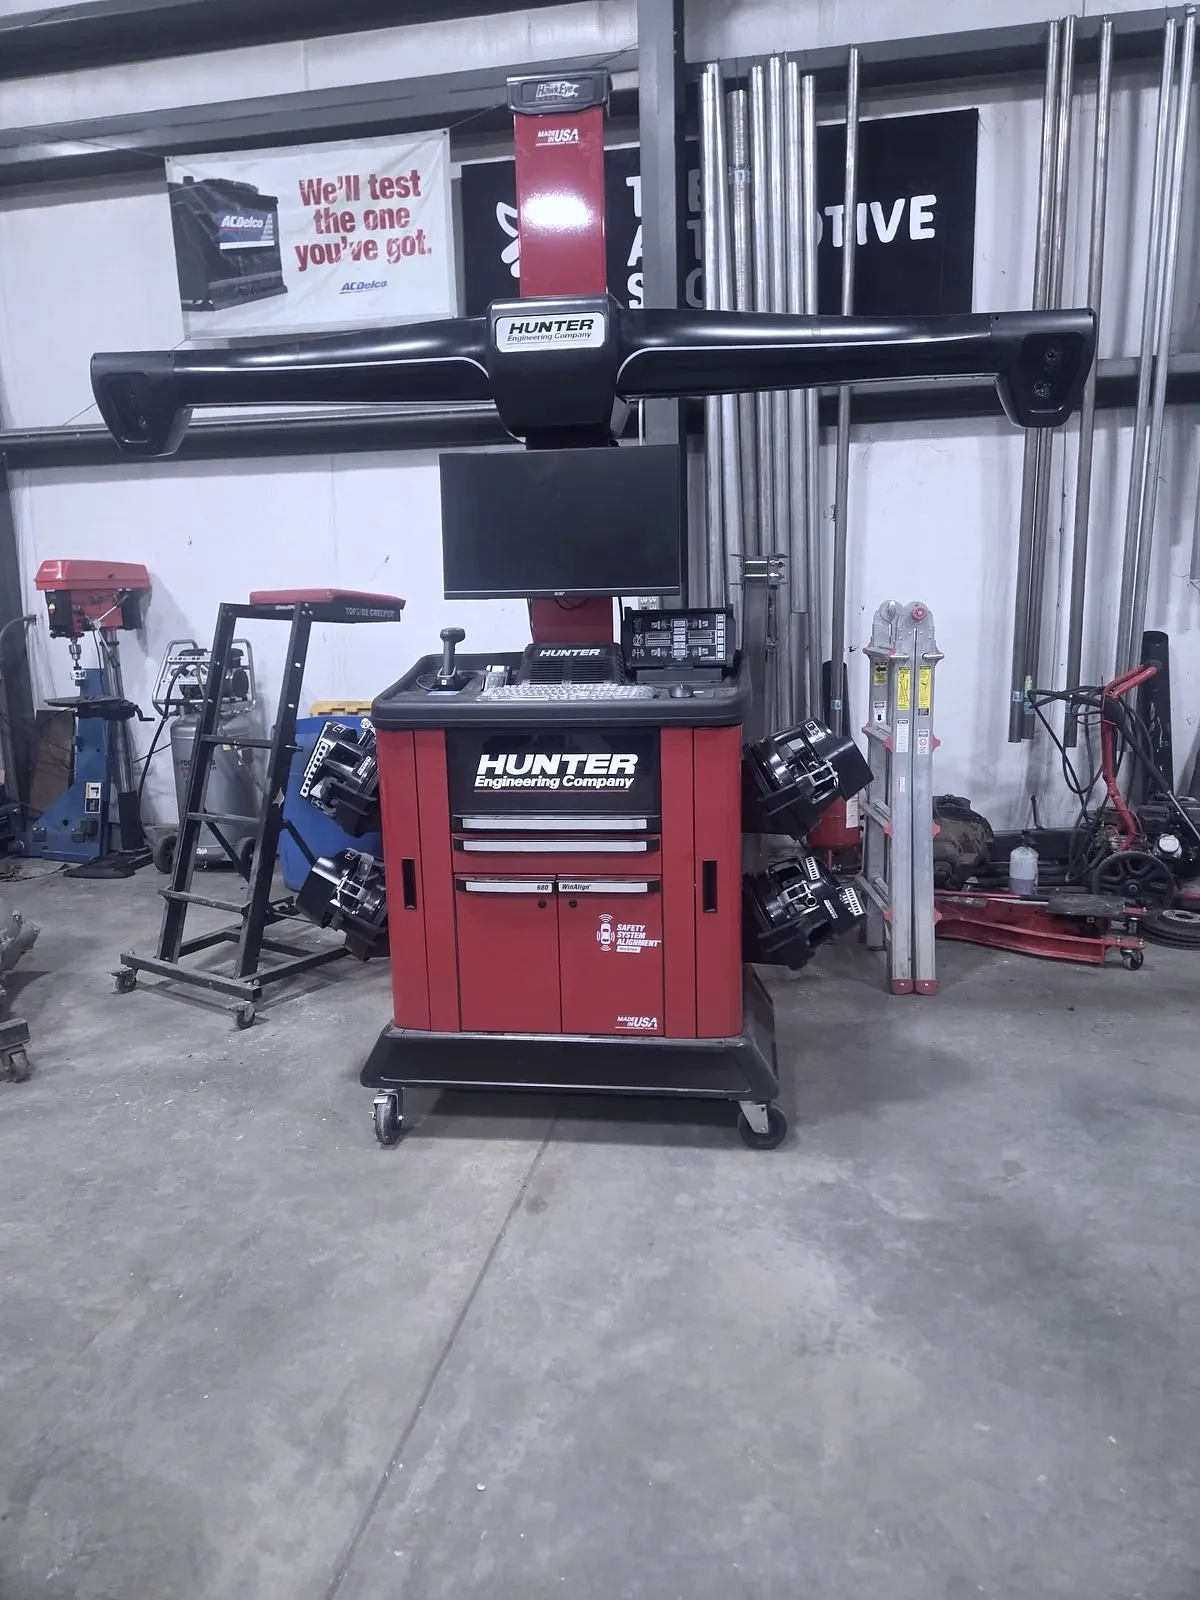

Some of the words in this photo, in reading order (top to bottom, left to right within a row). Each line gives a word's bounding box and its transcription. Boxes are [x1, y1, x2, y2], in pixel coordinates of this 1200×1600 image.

[538, 130, 556, 138] MADE
[555, 128, 579, 142] USA
[299, 174, 361, 206] We'll
[367, 169, 422, 201] test
[220, 214, 264, 229] ACDelco
[313, 207, 356, 235] the
[363, 206, 411, 231] one
[294, 236, 379, 272] you've
[386, 229, 433, 265] got.
[341, 279, 387, 293] ACDelco
[509, 319, 594, 334] HUNTER
[507, 333, 552, 342] Engineering
[554, 331, 592, 340] Company
[539, 648, 601, 657] HUNTER
[477, 754, 639, 775] HUNTER
[474, 775, 560, 790] Engineering
[562, 775, 635, 790] Company
[617, 924, 645, 932] SAFETY
[617, 931, 646, 939] SYSTEM
[617, 938, 659, 947] ALIGNMENT
[634, 1017, 658, 1027] USA
